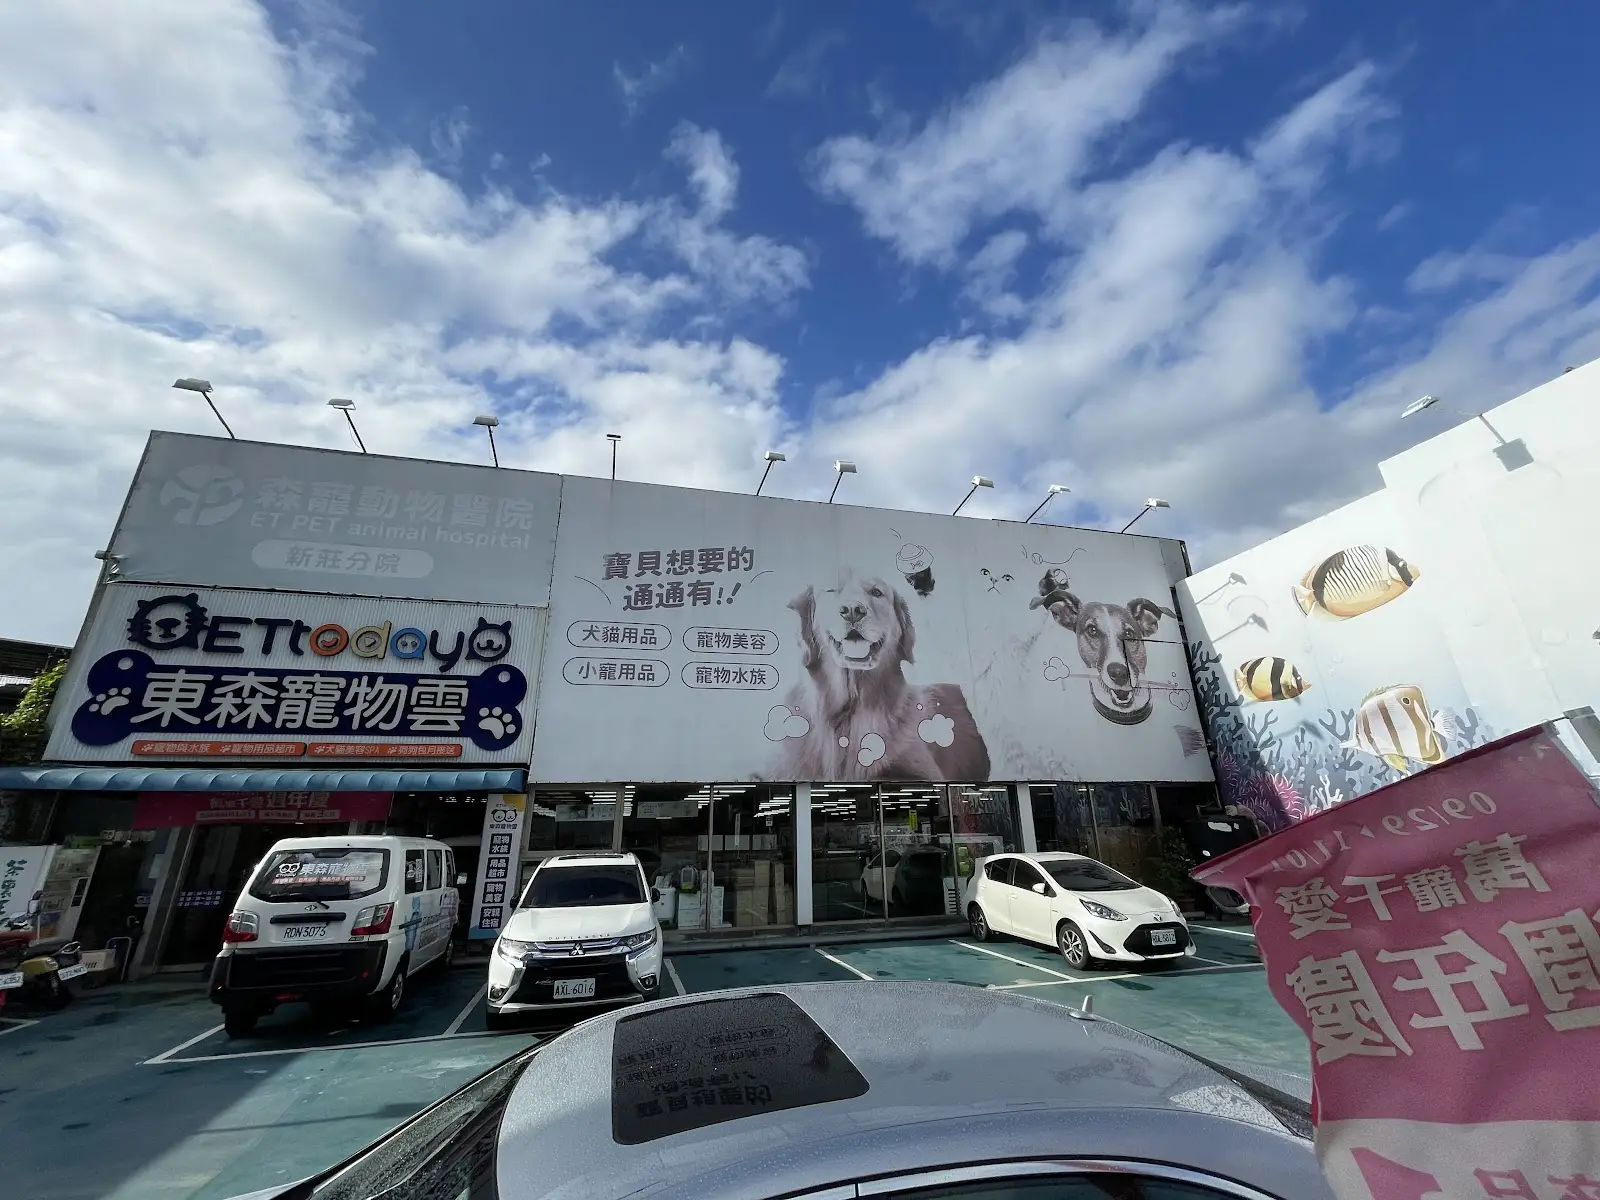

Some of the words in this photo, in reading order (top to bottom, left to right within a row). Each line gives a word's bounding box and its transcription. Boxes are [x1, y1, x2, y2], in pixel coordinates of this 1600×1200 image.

[256, 475, 535, 531] 森寵動物醫院
[251, 512, 283, 528] ET
[292, 515, 341, 533] PET
[348, 522, 427, 542] animal
[435, 527, 530, 550] hospital
[284, 546, 401, 574] 新莊分院
[602, 546, 755, 580] 寶貝想要的
[202, 615, 466, 673] ETtoday
[582, 624, 658, 646] 犬貓用品
[696, 631, 766, 650] 寵物美容
[578, 661, 655, 682] 小寵用品
[696, 666, 767, 685] 寵物水族
[130, 670, 469, 732] 東森寵物雲
